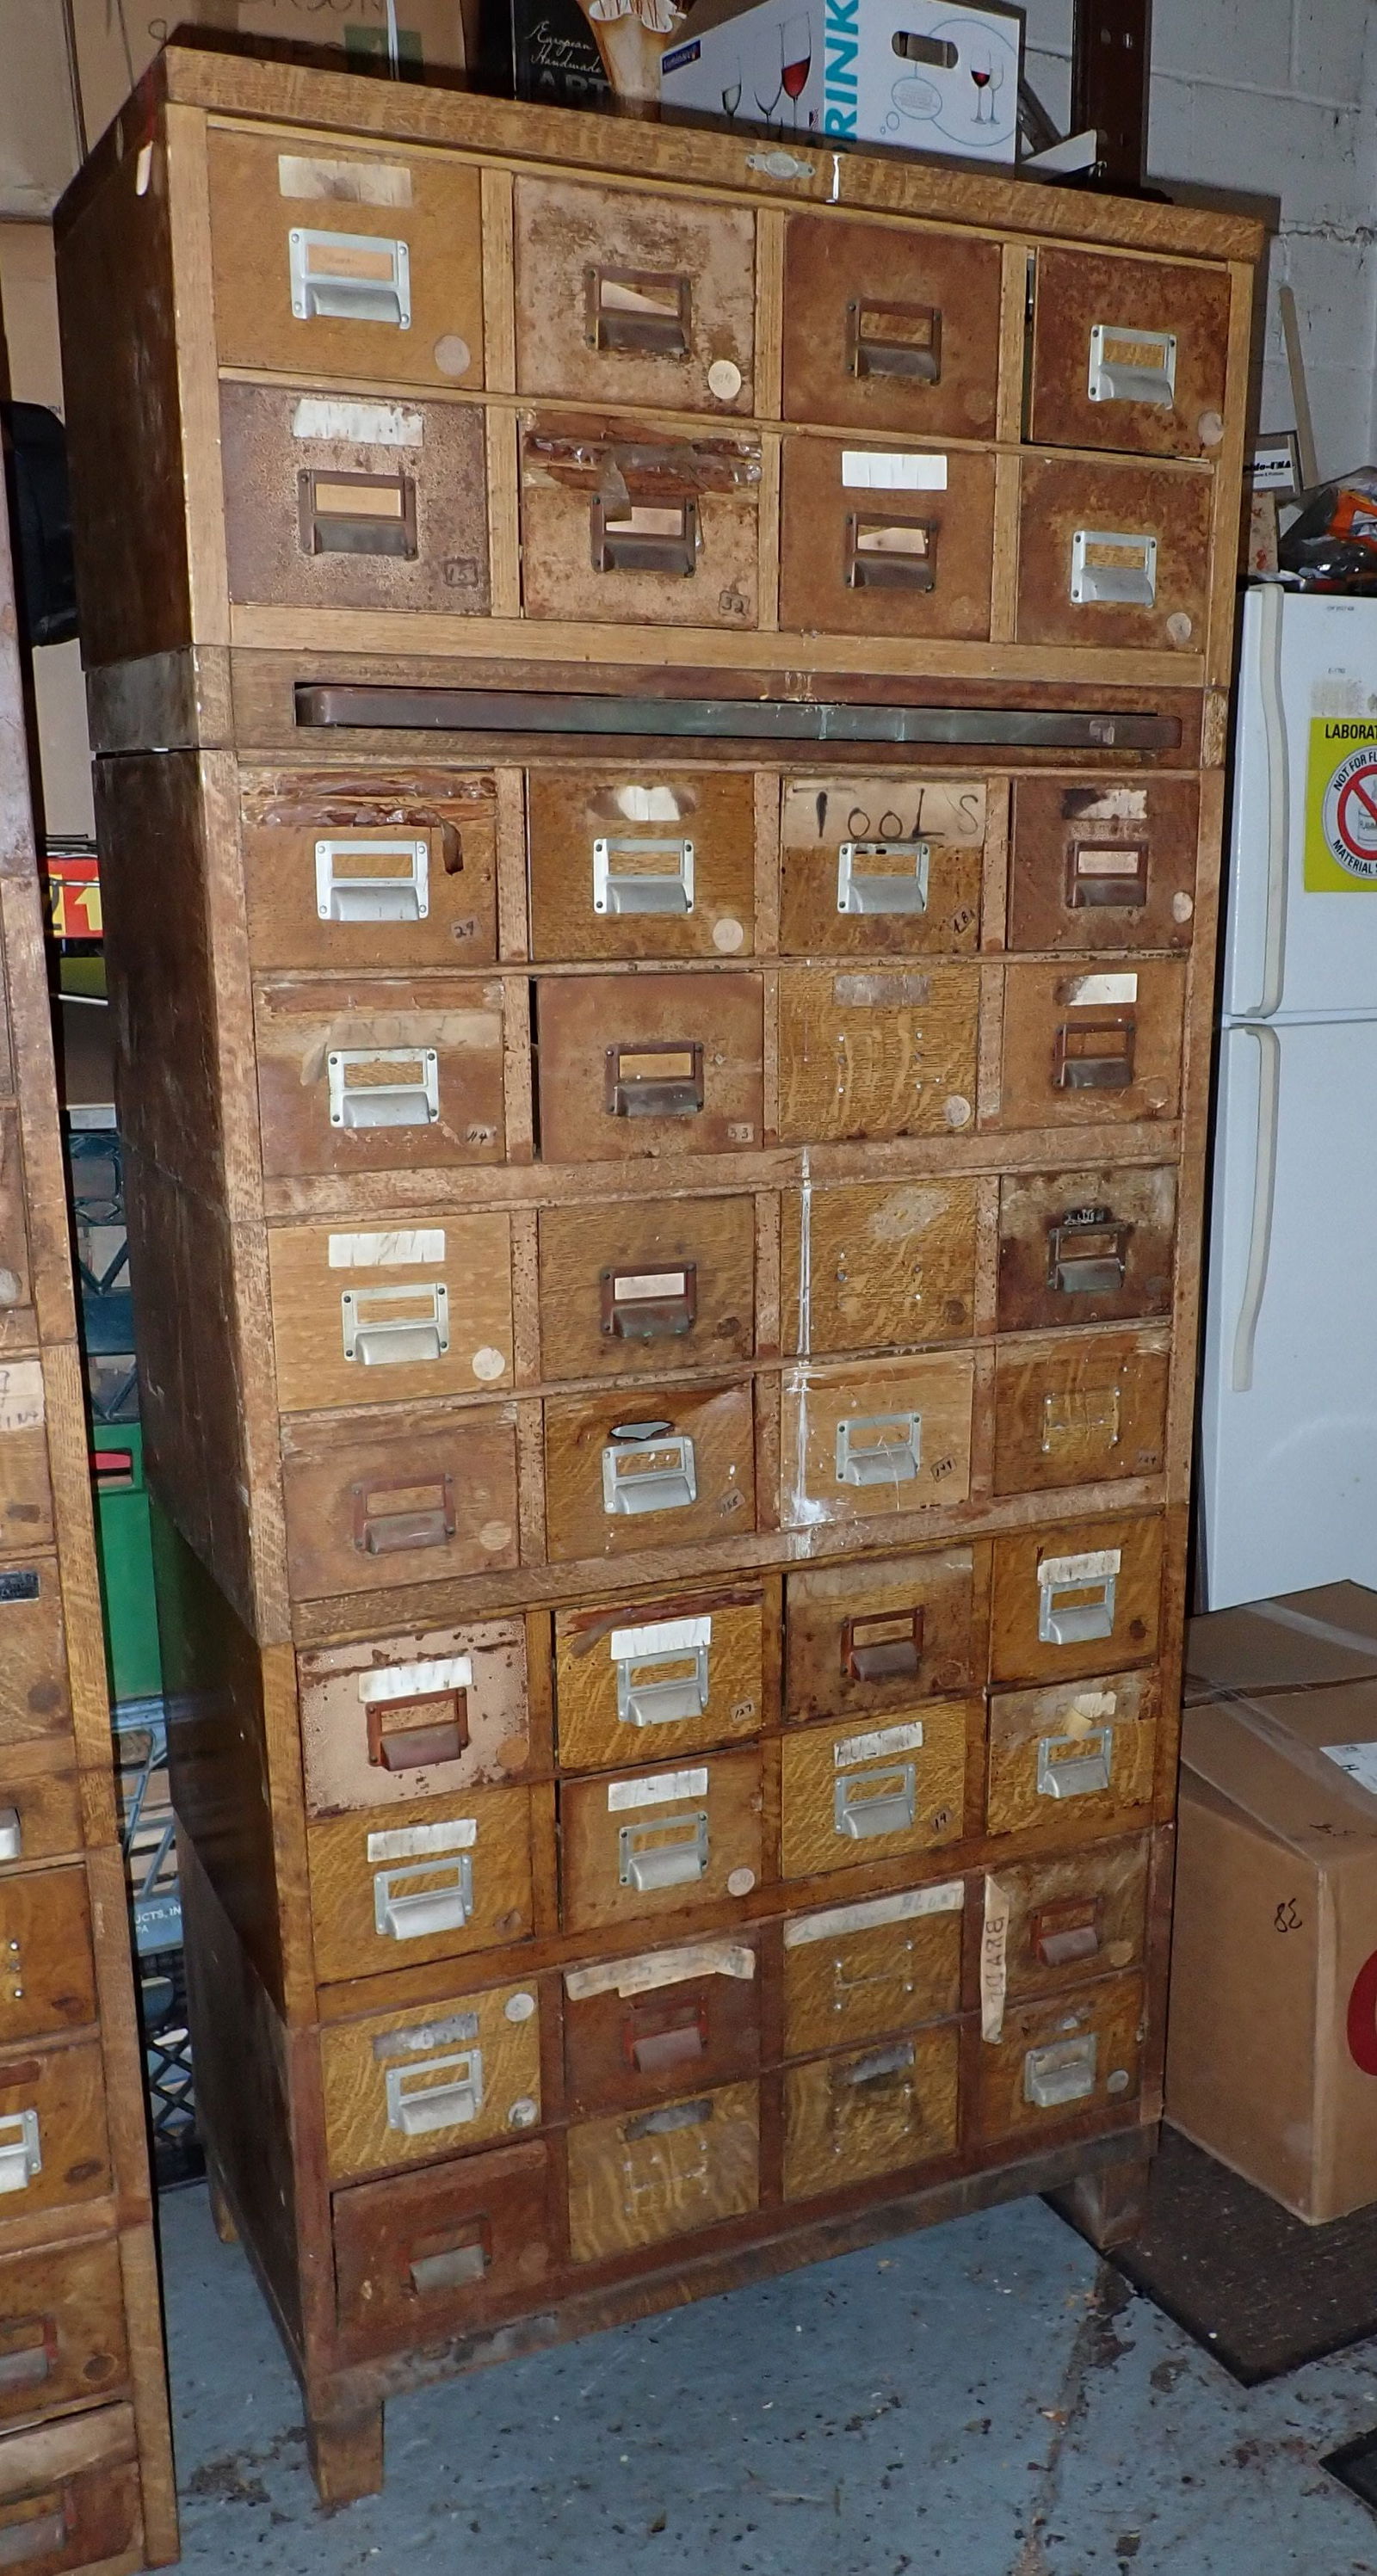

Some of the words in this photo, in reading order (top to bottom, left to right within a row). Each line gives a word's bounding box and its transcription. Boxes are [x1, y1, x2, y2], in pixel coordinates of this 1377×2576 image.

[525, 20, 594, 56] European
[1333, 767, 1349, 792] NOT
[1349, 754, 1367, 772] FOR
[1333, 839, 1373, 874] MATERIAL
